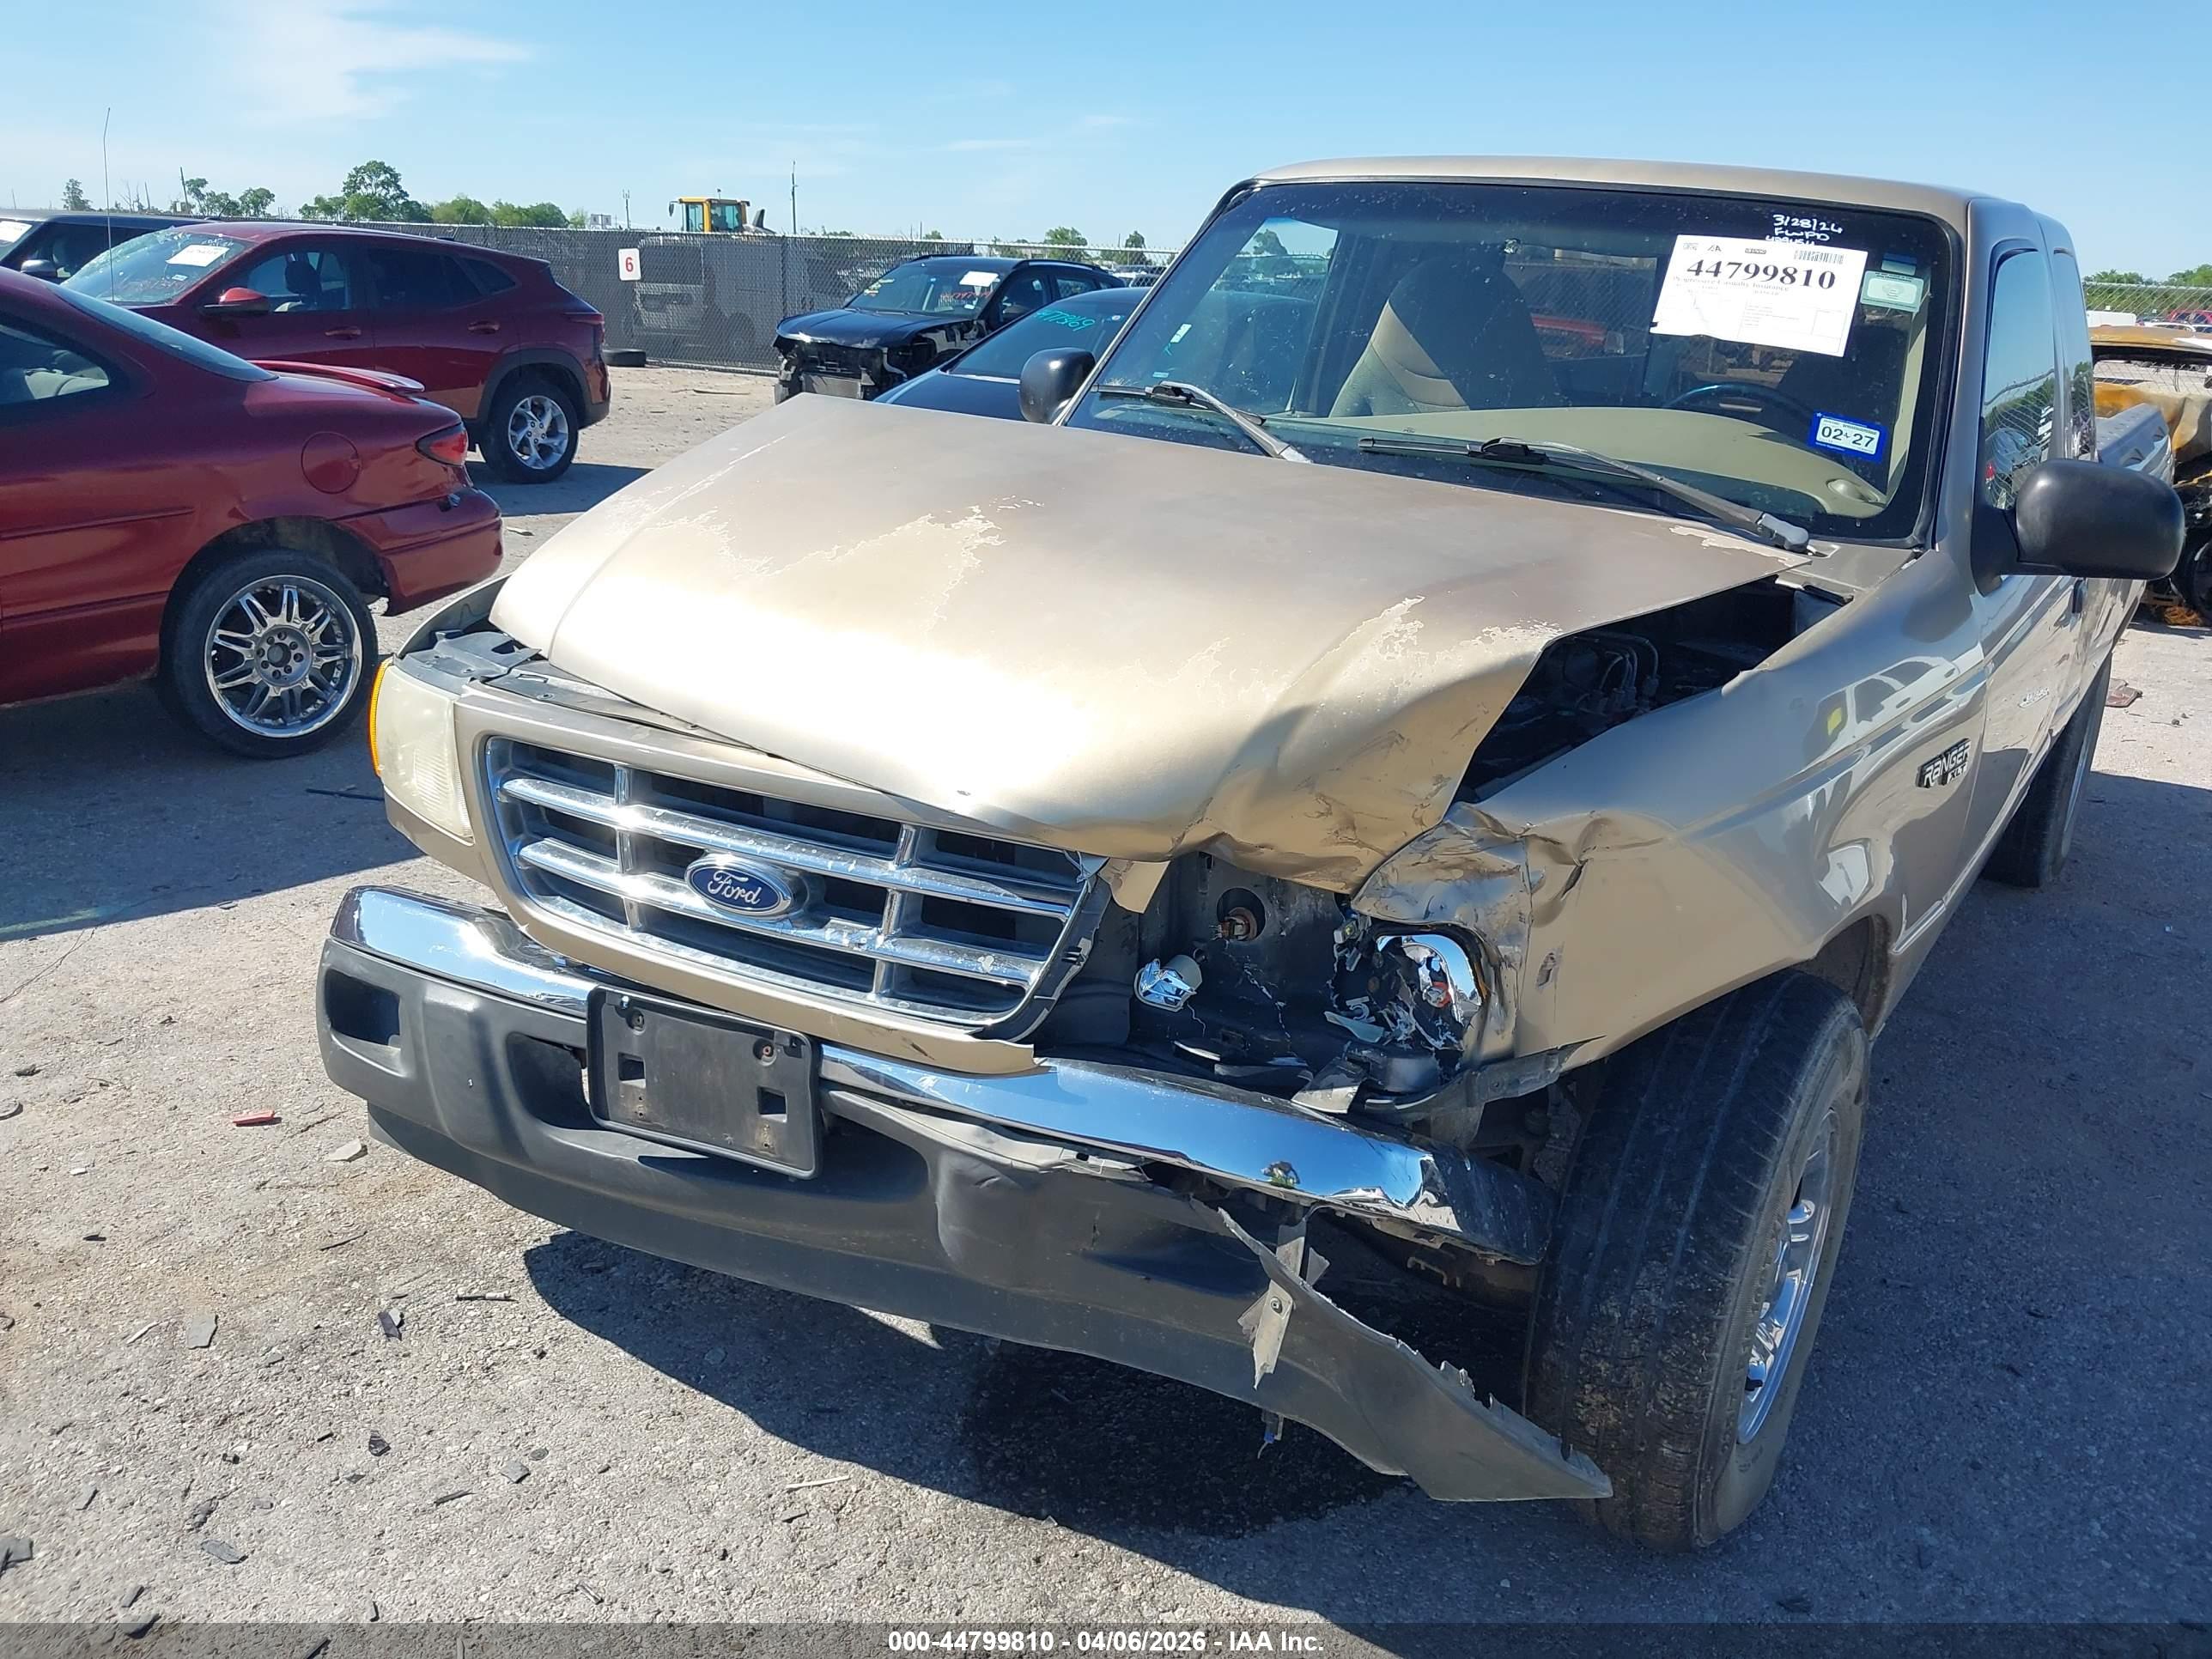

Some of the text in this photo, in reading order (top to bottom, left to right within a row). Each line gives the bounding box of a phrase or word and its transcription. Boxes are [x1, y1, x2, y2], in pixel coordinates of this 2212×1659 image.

[625, 257, 634, 272] 6
[1686, 258, 1836, 289] 44799810
[1821, 426, 1844, 441] 02
[1851, 433, 1875, 447] 27
[1922, 739, 1972, 787] RANGER
[1947, 761, 1969, 785] XLT
[708, 870, 763, 905] Ford
